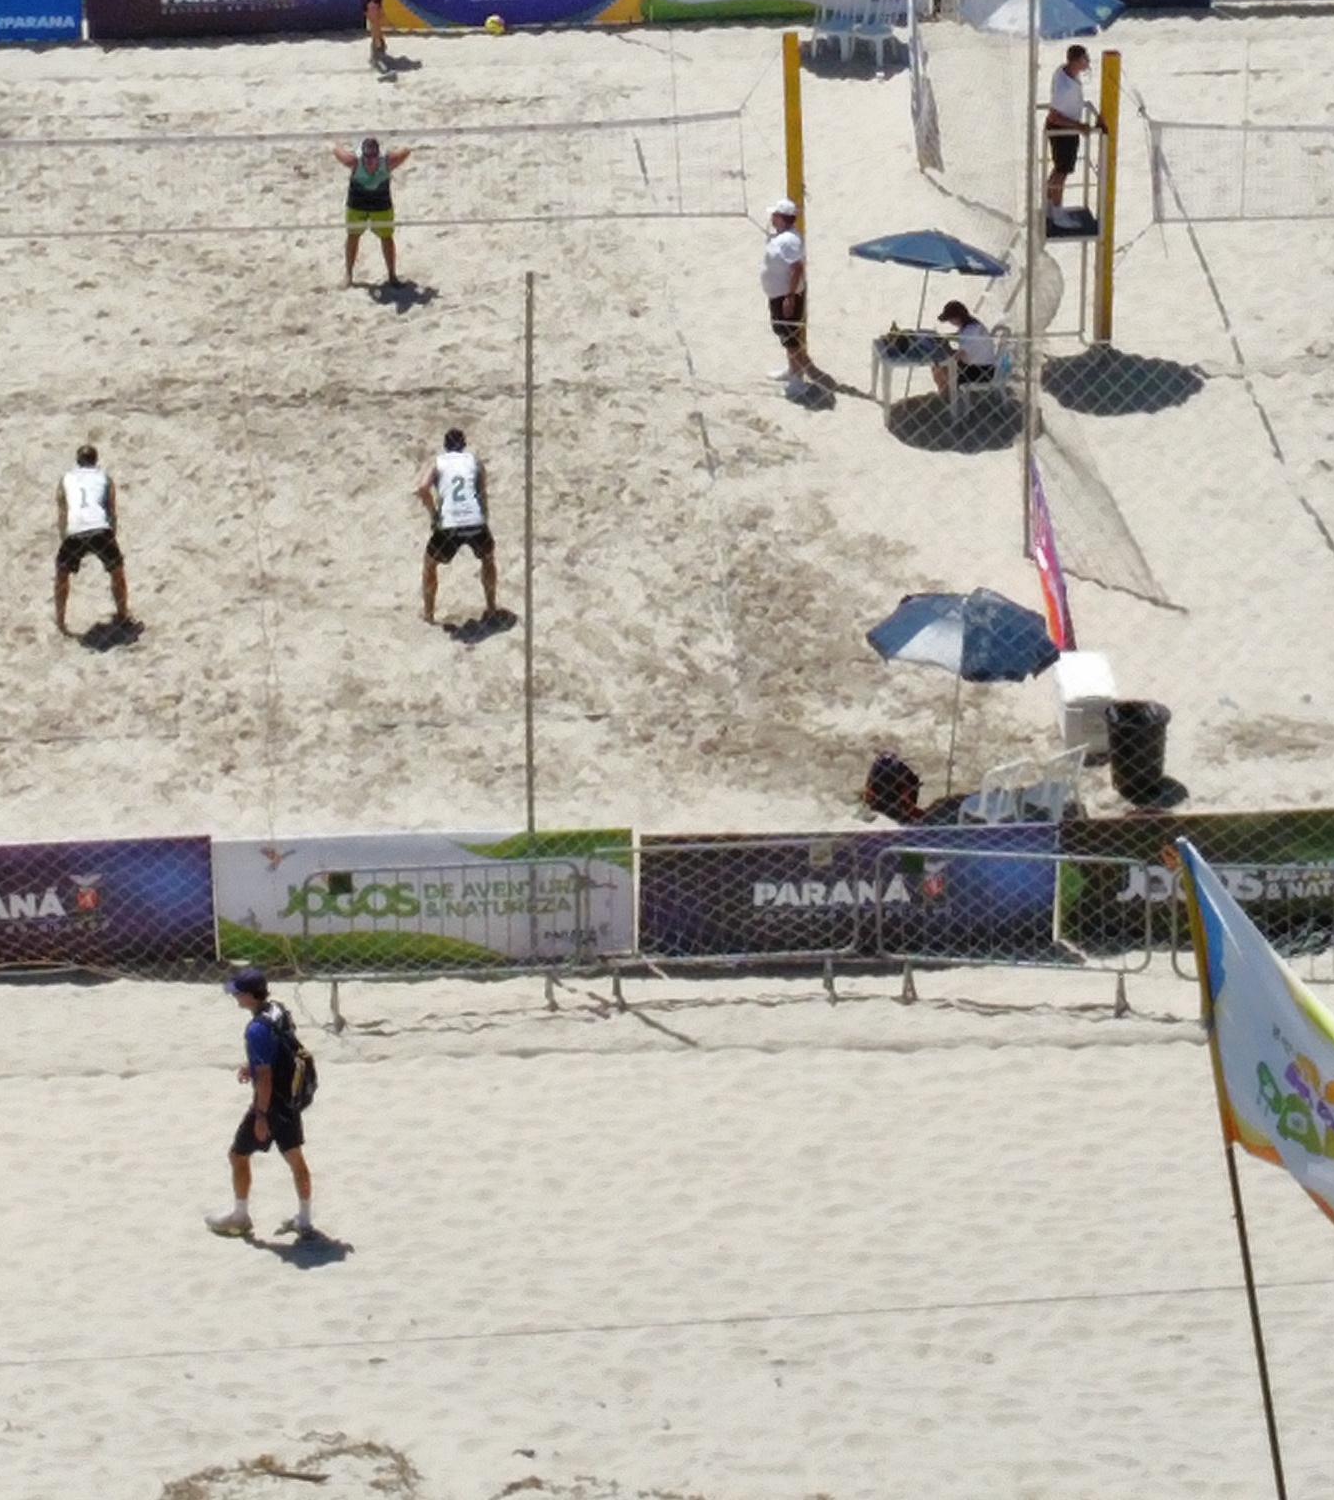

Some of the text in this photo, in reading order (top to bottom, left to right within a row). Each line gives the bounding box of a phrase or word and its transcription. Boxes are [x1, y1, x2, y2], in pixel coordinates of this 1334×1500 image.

[78, 486, 89, 509] 1
[450, 476, 468, 502] 2
[424, 882, 454, 898] DE
[753, 873, 912, 907] PARANÁ
